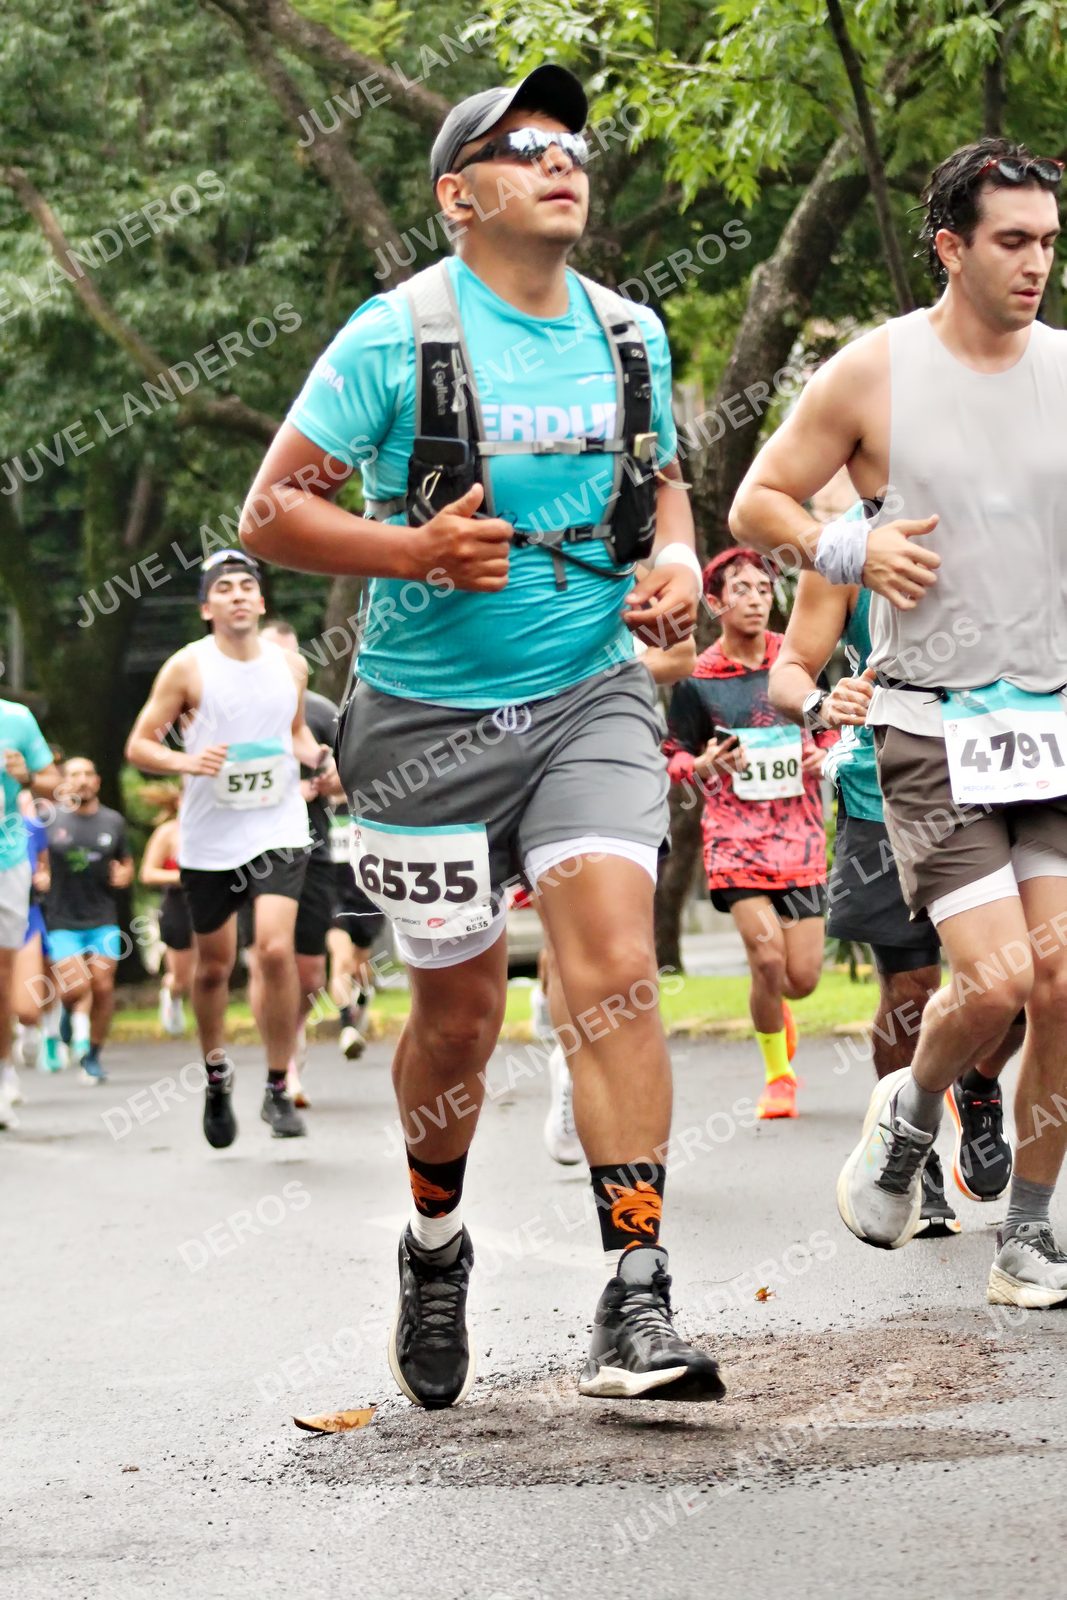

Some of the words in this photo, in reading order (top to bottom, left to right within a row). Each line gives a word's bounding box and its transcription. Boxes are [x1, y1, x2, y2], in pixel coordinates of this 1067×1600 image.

[961, 731, 1065, 773] 4791
[228, 770, 273, 792] 573
[359, 854, 478, 904] 6535
[466, 921, 488, 932] 6535
